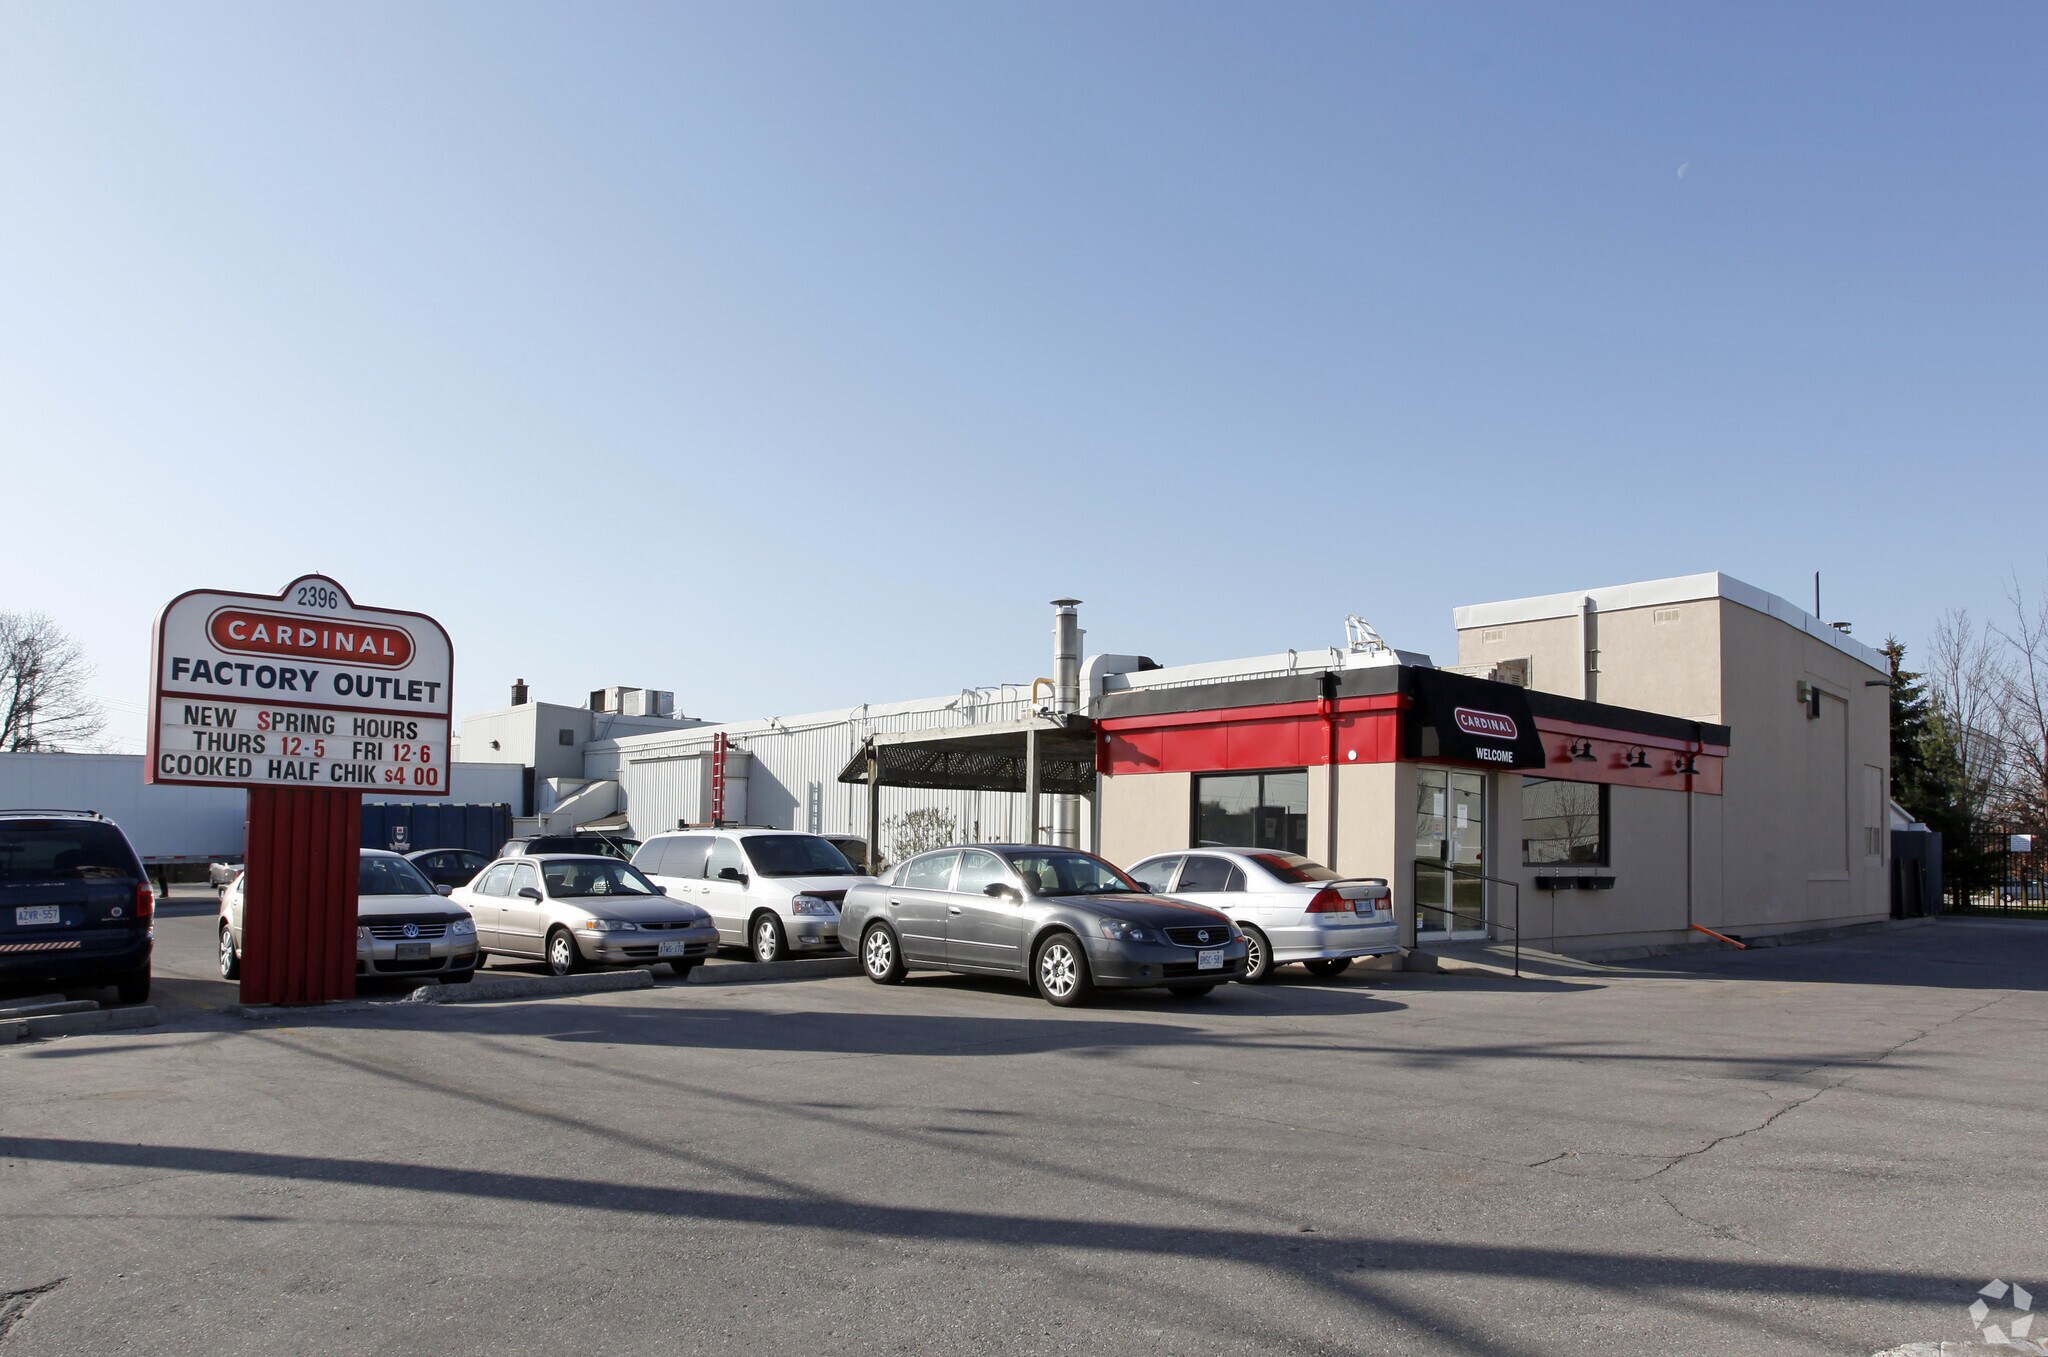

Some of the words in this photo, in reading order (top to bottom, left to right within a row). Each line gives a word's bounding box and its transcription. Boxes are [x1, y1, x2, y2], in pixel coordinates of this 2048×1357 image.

[298, 586, 338, 609] 2396
[228, 620, 396, 657] CARDINAL
[171, 656, 320, 693] FACTORY
[333, 672, 441, 703] OUTLET
[184, 704, 237, 728] NEW
[257, 711, 335, 735] SPRING
[353, 717, 418, 740] HOURS
[1460, 714, 1513, 733] CARDINAL
[193, 730, 266, 754] THURS
[353, 741, 383, 761] FRI
[1475, 746, 1514, 763] WELCOME
[161, 753, 252, 778] COOKED
[268, 759, 320, 781] HALF
[330, 763, 377, 784] CHIK
